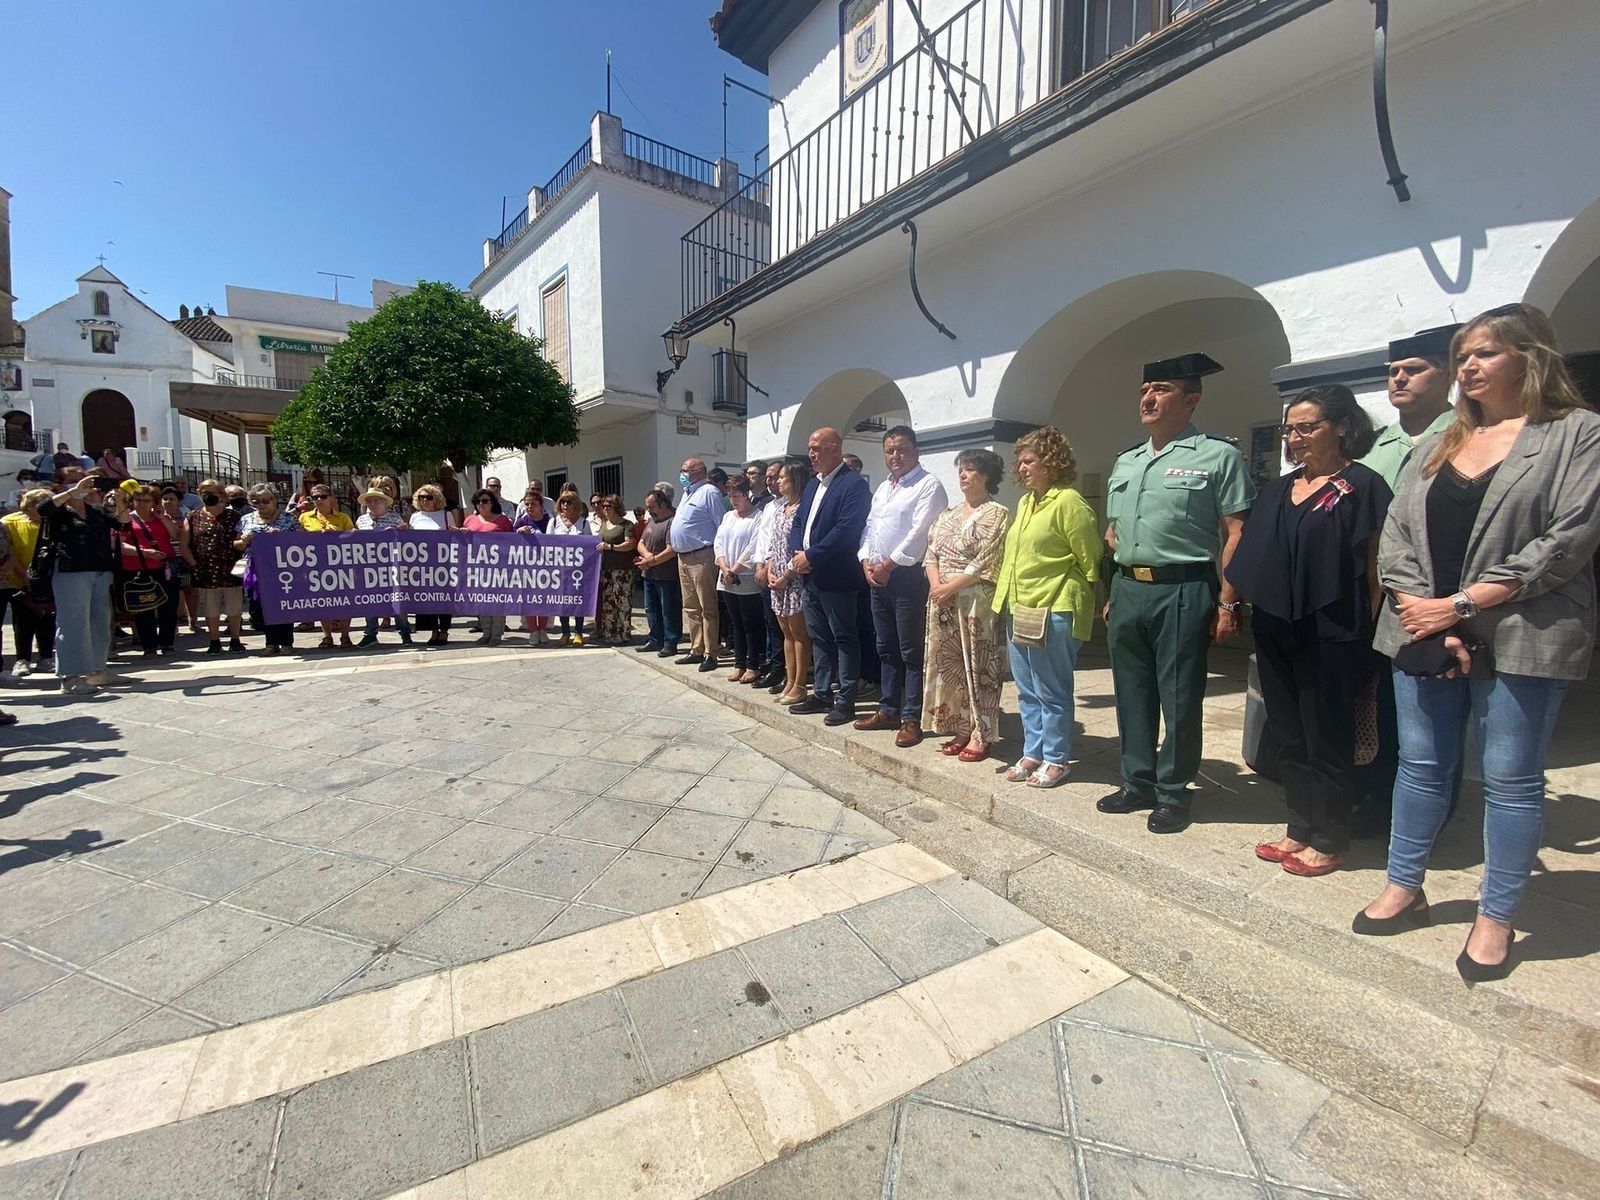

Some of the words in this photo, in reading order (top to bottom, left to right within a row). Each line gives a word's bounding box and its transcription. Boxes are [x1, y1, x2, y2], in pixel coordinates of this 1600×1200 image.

[275, 545, 317, 568] LOS
[327, 541, 429, 566] DERECHOS
[437, 542, 459, 564] DE
[467, 543, 500, 565] LAS
[507, 545, 584, 567] MUJERES
[308, 568, 355, 592] SON
[363, 566, 459, 589] DERECHOS
[466, 567, 561, 590] HUMANOS
[280, 595, 350, 610] PLATAFORMA
[354, 592, 411, 605] CORDOBESA
[413, 592, 451, 602] CONTRA
[454, 593, 465, 602] LA
[468, 593, 514, 603] VIOLENCIA
[516, 594, 524, 603] A
[527, 594, 543, 604] LAS
[546, 595, 583, 605] MUJERES
